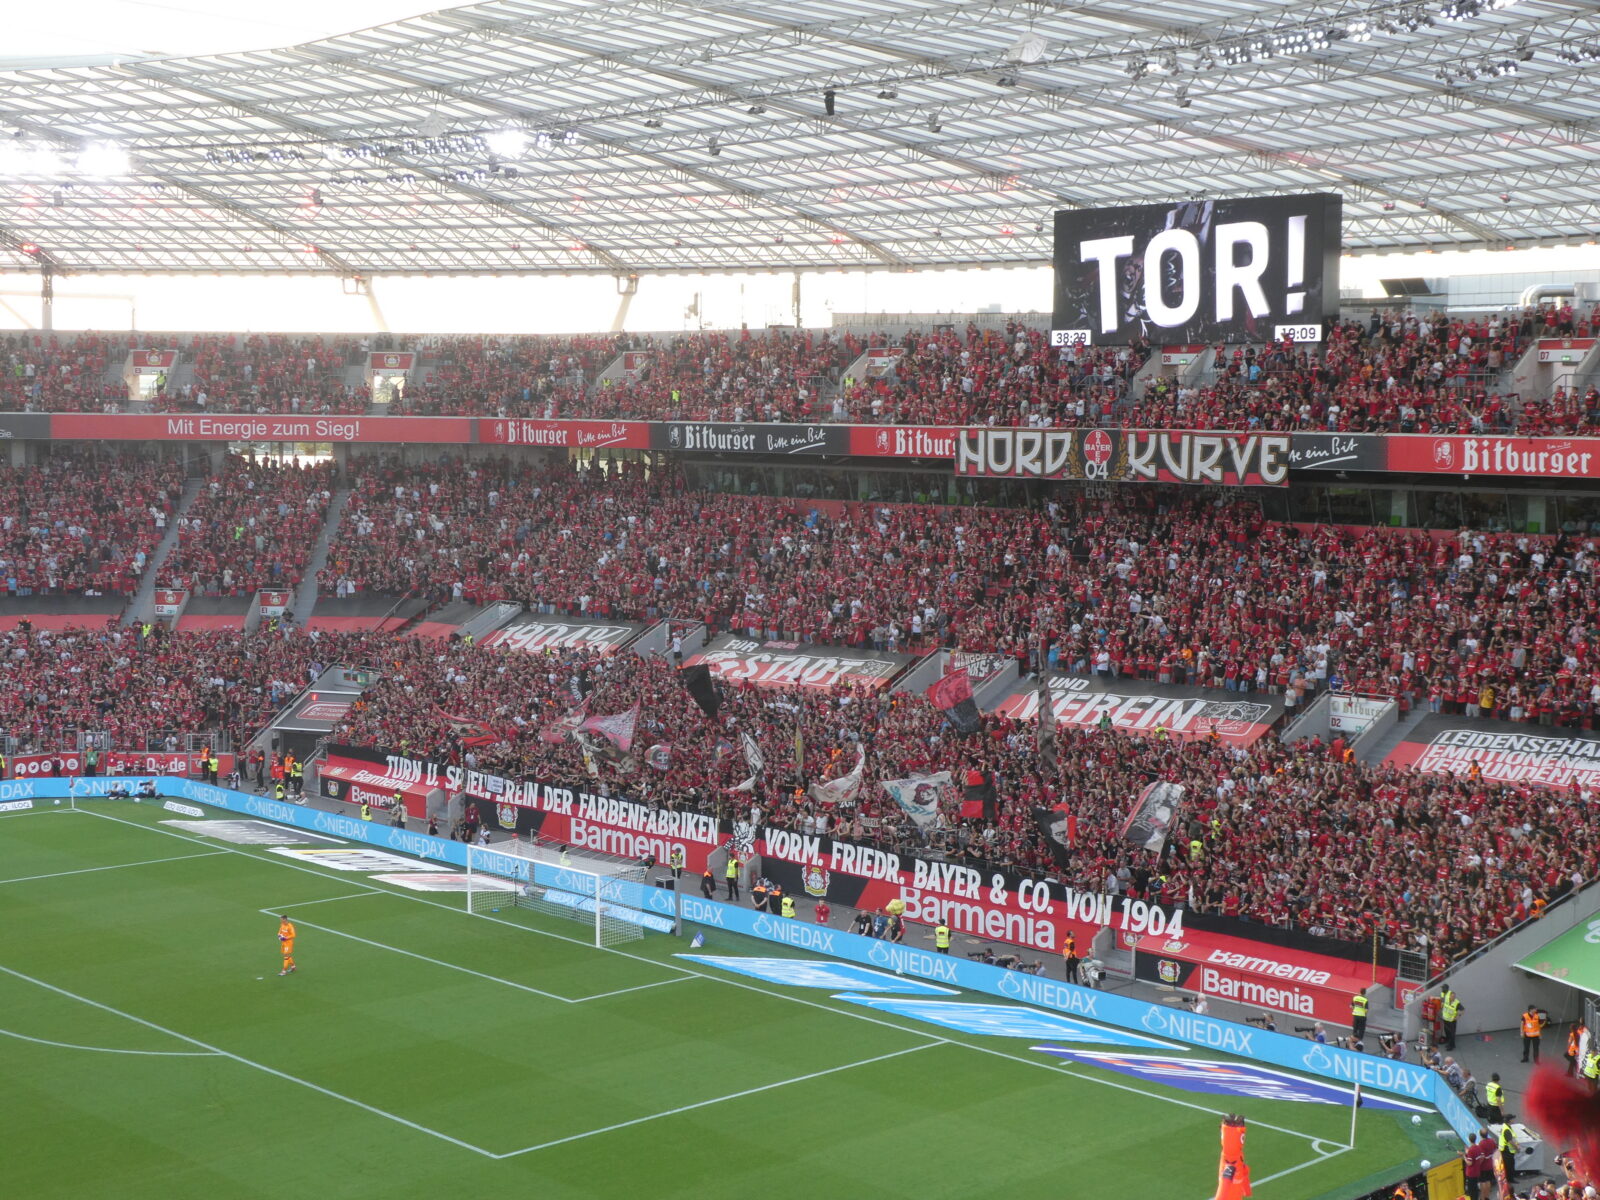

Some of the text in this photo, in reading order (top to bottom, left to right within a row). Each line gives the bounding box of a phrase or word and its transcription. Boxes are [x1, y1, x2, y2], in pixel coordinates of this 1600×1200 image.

[1080, 214, 1308, 334] TOR!
[1056, 331, 1087, 345] 38:29
[168, 418, 360, 442] Mit Energie zum Sieg!
[508, 420, 567, 446] Bitburger
[684, 424, 756, 451] Bitburger
[808, 426, 825, 443] Bit
[1085, 460, 1109, 480] 04
[1462, 439, 1592, 475] Bitburger
[724, 639, 759, 652] FÜR
[1048, 677, 1090, 691] UND
[1020, 691, 1206, 730] VEREIN
[1331, 717, 1341, 727] D2
[352, 769, 413, 791] Barmenia
[193, 786, 228, 808] NIEDAX
[351, 785, 399, 810] Barmen
[256, 798, 296, 823] NIEDAX
[326, 814, 369, 840] NIEDAX
[386, 755, 422, 783] TURN
[427, 763, 438, 786] U.
[543, 785, 572, 816] DER
[578, 792, 719, 846] FARBENFABRIKEN
[765, 827, 824, 866] VORM.
[831, 842, 905, 885] FRIEDR.
[914, 859, 981, 902] BAYER
[990, 874, 1008, 906] &
[1019, 879, 1053, 915] CO.
[1066, 886, 1112, 923] VON
[1121, 899, 1184, 940] 1904
[400, 831, 447, 859] NIEDAX
[570, 817, 687, 869] Barmenia
[483, 851, 531, 877] NIEDAX
[901, 885, 1056, 950] Barmenia
[773, 922, 835, 953] NIEDAX
[889, 948, 958, 984] NIEDAX
[1022, 980, 1097, 1017] NIEDAX
[1203, 968, 1314, 1014] Barmenia
[1168, 1014, 1255, 1055] NIEDAX
[1334, 1053, 1428, 1097] NIEDAX
